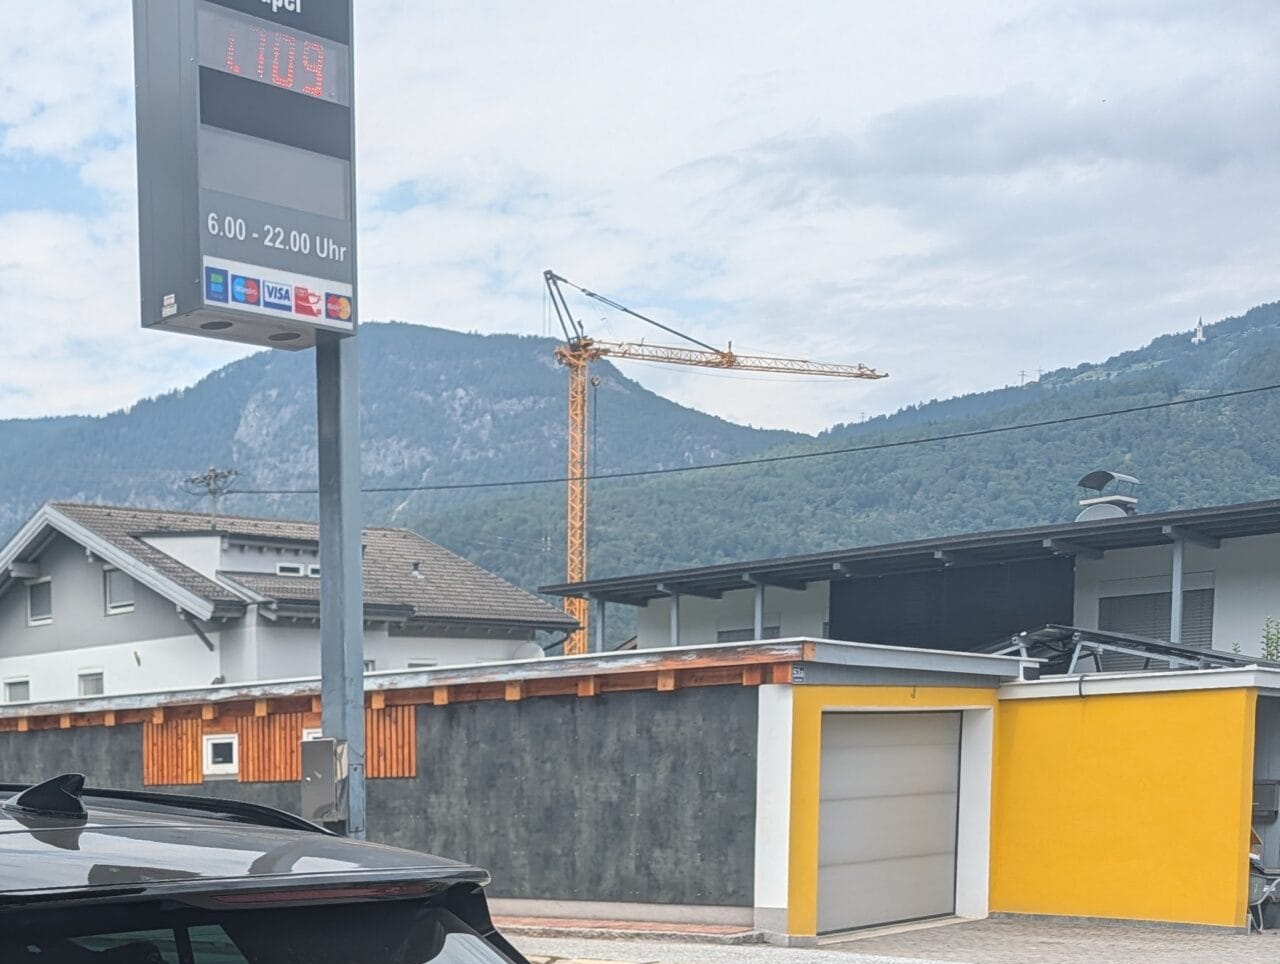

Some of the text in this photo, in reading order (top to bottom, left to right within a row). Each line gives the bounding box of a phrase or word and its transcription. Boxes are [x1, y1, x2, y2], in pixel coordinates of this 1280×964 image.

[207, 212, 246, 240] 6.00
[263, 224, 310, 254] 22.00
[316, 235, 347, 261] Uhr
[266, 284, 291, 303] VISA
